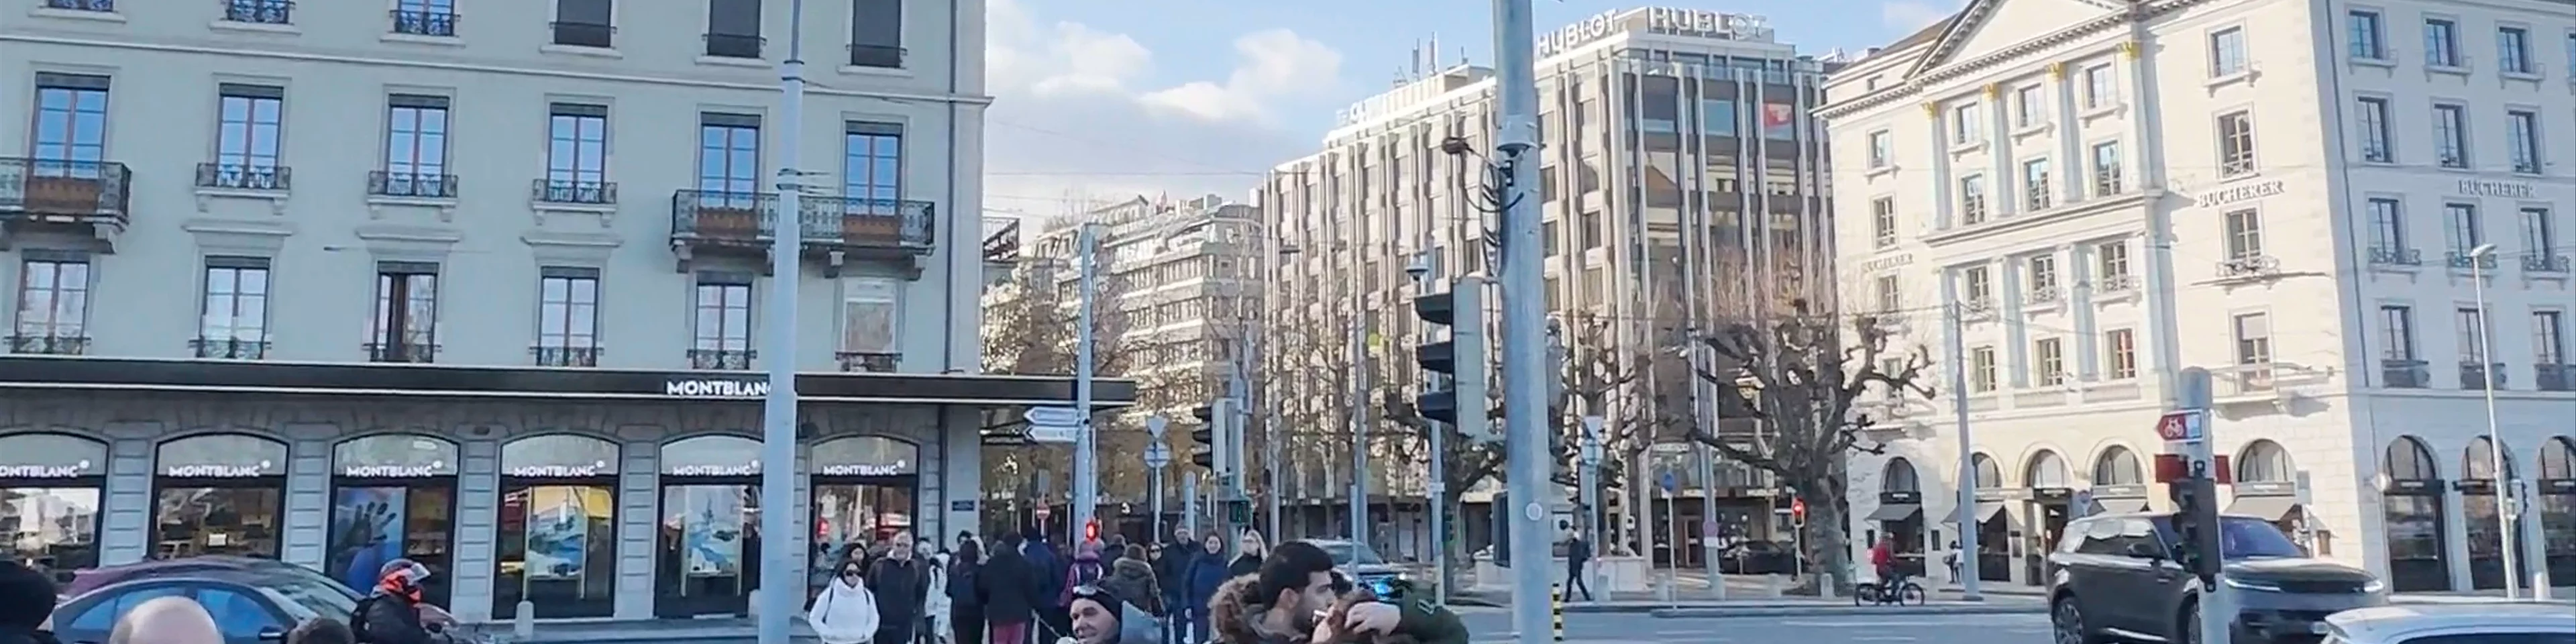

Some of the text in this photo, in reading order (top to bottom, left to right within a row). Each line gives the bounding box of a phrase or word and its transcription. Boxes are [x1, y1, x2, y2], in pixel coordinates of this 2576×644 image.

[1647, 5, 1767, 36] HUBLOT
[1537, 9, 1616, 58] HUBLOT
[2197, 180, 2285, 207] BUCHERER
[667, 380, 771, 396] MONTBLAN
[0, 466, 78, 478] ONTBLANC
[168, 465, 260, 477] MONTBLANC
[346, 465, 433, 477] MONTBLANC
[513, 465, 596, 477] MONTBLANC
[673, 465, 751, 476] MONTBLANC
[823, 465, 898, 476] MONTBLANC
